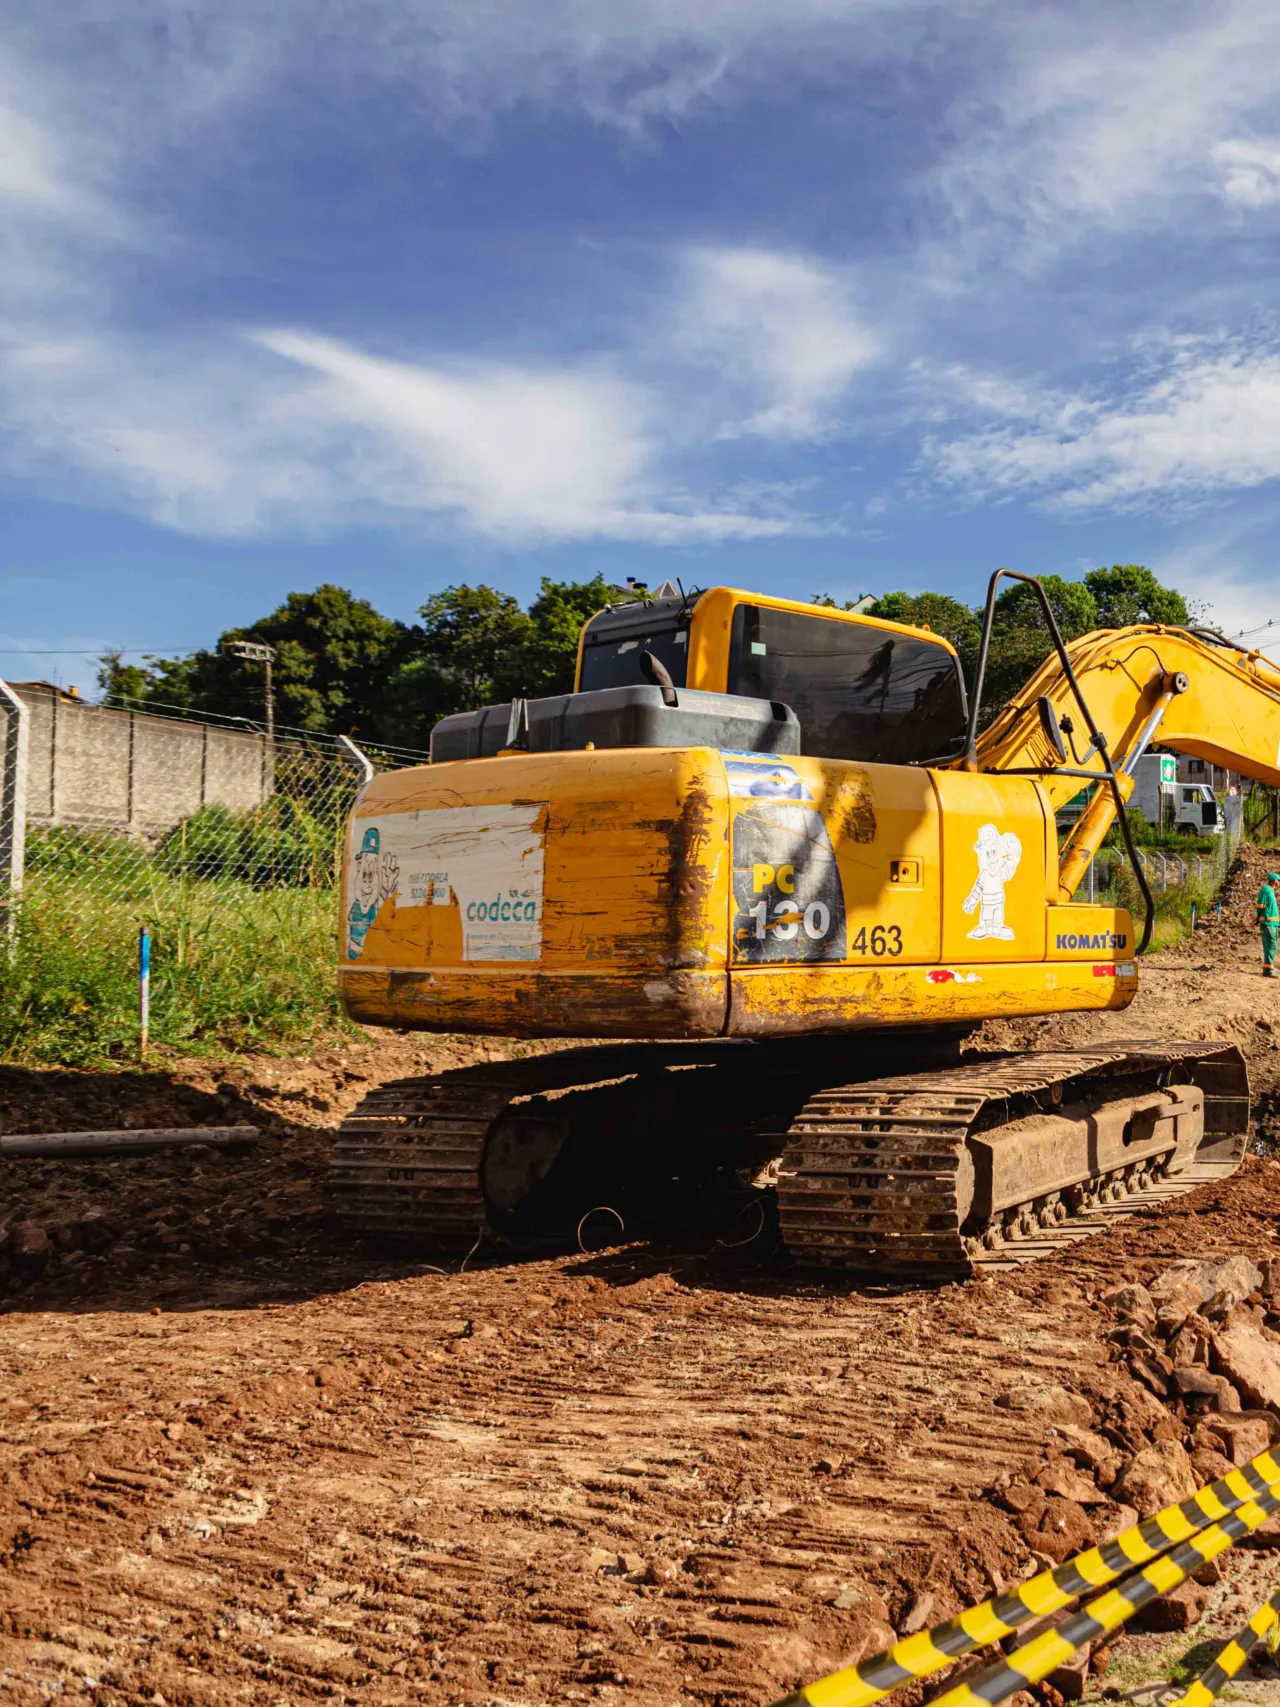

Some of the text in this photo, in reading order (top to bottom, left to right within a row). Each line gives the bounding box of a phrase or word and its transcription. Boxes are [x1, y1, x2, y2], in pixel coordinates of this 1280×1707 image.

[753, 863, 795, 894] PC
[466, 892, 537, 922] codeca
[749, 900, 831, 940] 130
[852, 925, 903, 957] 463
[1056, 930, 1127, 949] KOMATSU
